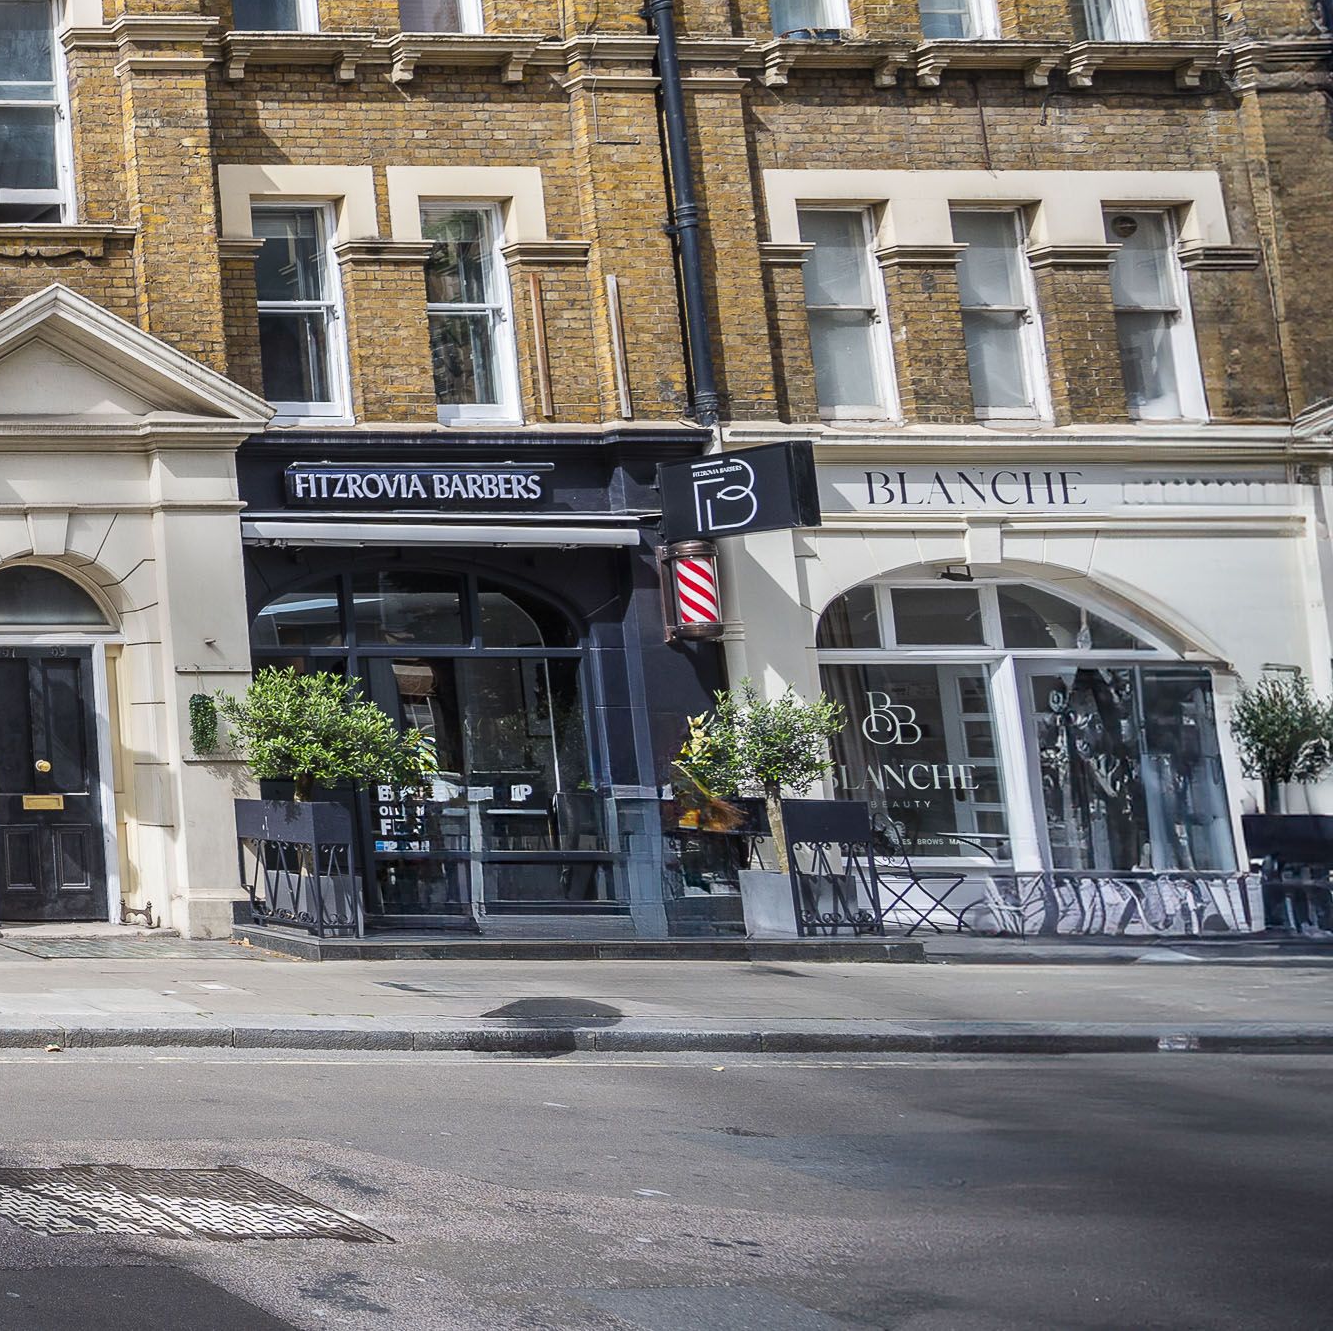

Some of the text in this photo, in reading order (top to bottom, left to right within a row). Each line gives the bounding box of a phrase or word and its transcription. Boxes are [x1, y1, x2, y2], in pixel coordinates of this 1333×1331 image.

[295, 473, 542, 499] FITZROVIA BARBERS
[864, 470, 1088, 506] BLANCHE
